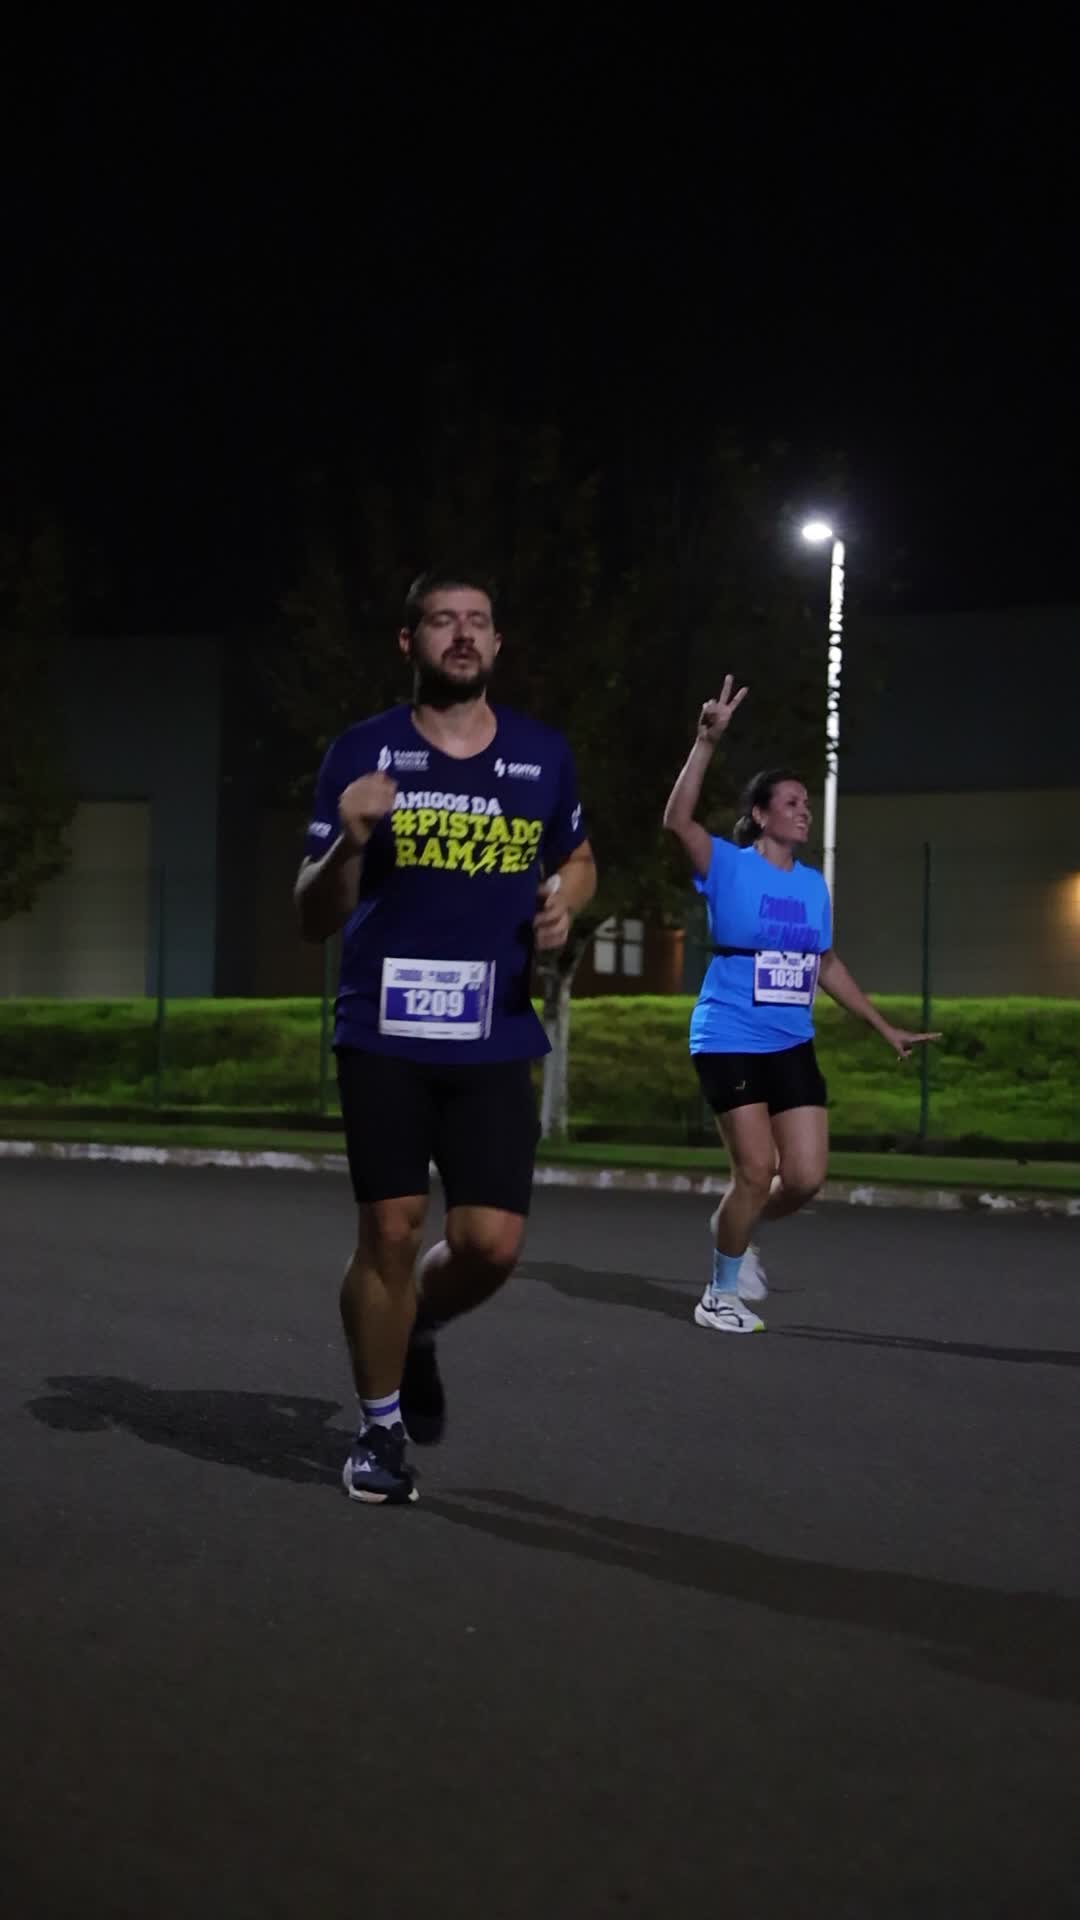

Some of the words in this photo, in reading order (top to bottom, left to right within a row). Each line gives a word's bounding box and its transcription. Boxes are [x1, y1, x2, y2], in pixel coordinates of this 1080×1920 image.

[392, 791, 470, 813] AMIGOS
[471, 796, 503, 816] DA
[391, 808, 544, 845] #PISTADO
[402, 989, 465, 1017] 1209
